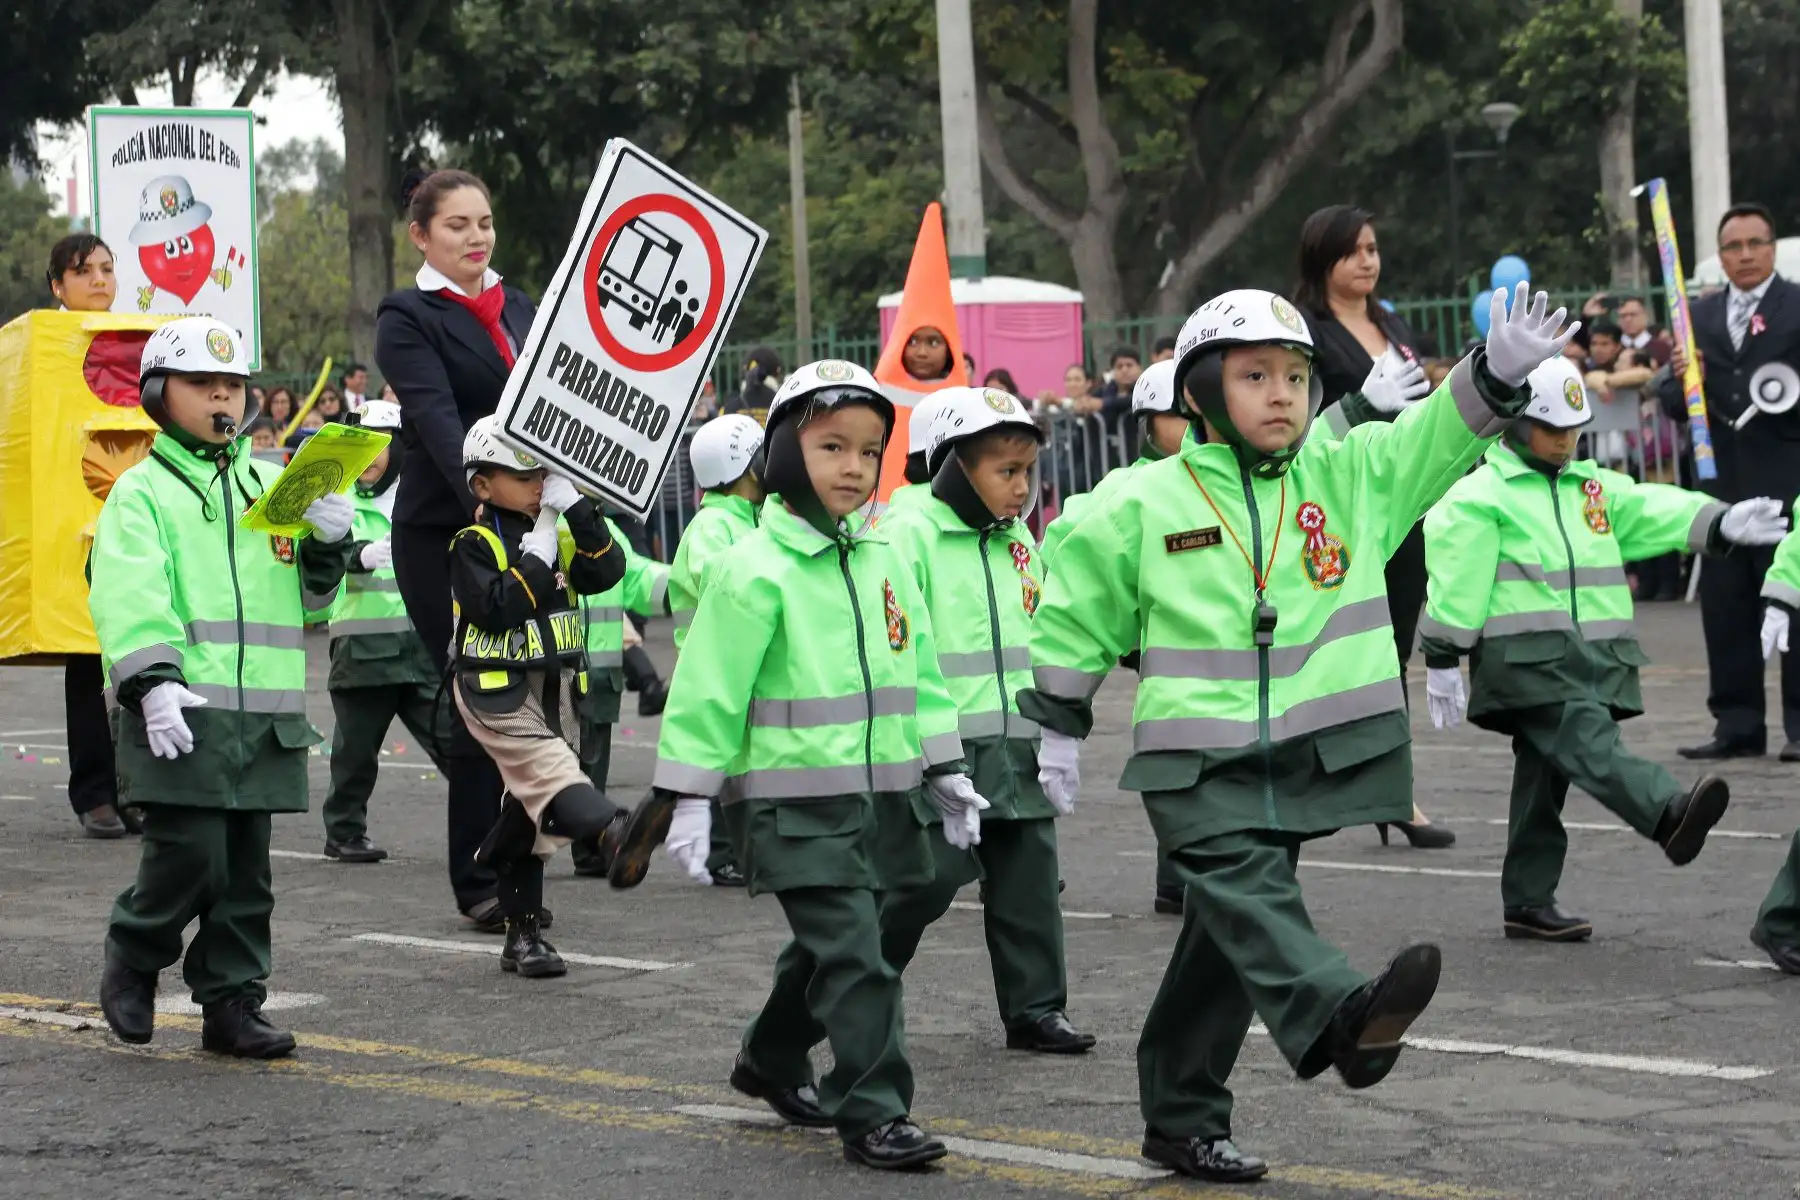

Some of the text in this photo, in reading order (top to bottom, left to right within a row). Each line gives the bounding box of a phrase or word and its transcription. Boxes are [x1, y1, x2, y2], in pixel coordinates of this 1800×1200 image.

[112, 130, 147, 168] POLICÍA
[148, 123, 196, 160] NACIONAL
[199, 128, 216, 162] DEL
[1199, 327, 1219, 341] Sur
[154, 355, 167, 367] Sur
[546, 341, 671, 442] PARADERO
[522, 395, 650, 496] AUTORIZADO
[462, 622, 545, 661] POLICA
